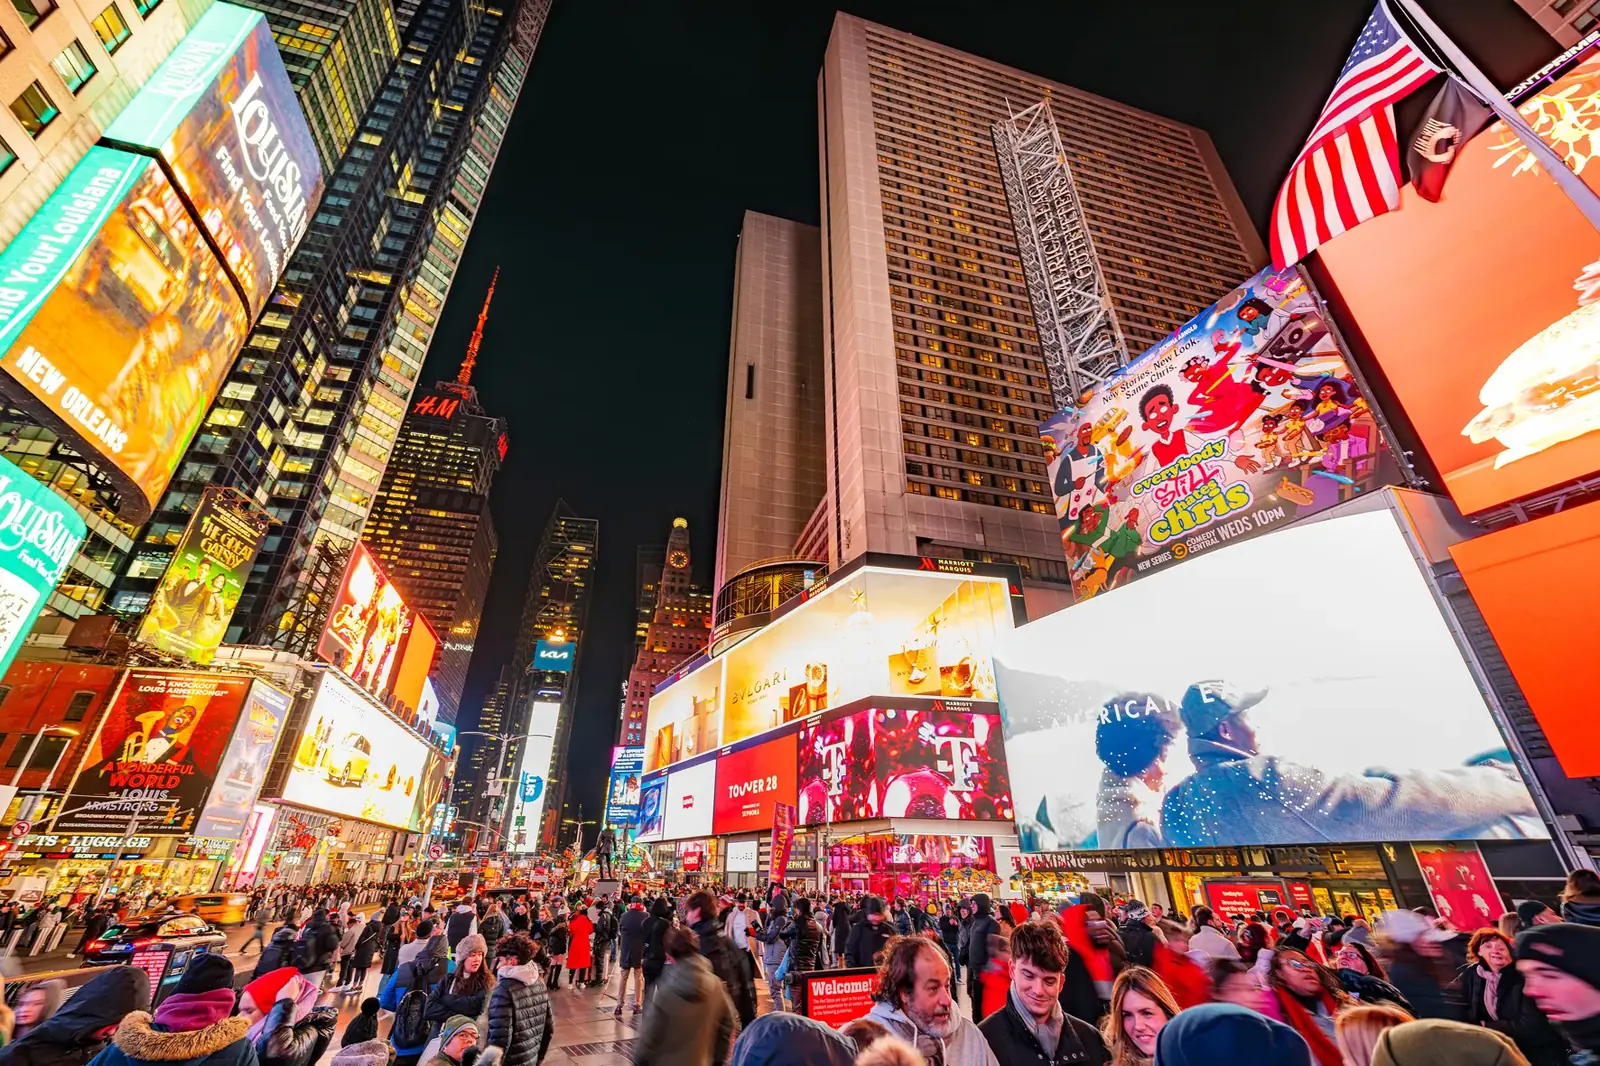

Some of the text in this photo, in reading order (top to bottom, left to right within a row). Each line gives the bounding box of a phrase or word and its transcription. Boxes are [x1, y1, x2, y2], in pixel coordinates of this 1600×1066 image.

[216, 145, 244, 193] Find
[239, 187, 264, 232] Your
[4, 242, 63, 283] Your
[38, 167, 123, 245] Louisiana
[1176, 323, 1198, 340] ARNOLD
[1102, 338, 1201, 405] New Stories. New Look.
[1125, 365, 1178, 400] Same Chris.
[16, 346, 128, 452] NEW ORLEANS
[413, 395, 460, 420] H&M
[1132, 439, 1226, 494] everybody
[1175, 480, 1218, 519] hates
[1150, 484, 1251, 543] chris
[200, 522, 222, 541] THE
[1217, 506, 1286, 540] WEDS 10PM
[219, 530, 255, 562] GREAT
[1186, 529, 1216, 548] COMEDY
[1188, 537, 1220, 555] CENTRAL
[200, 538, 244, 569] GATSBY
[1137, 550, 1173, 572] NEW SERIES
[938, 558, 975, 568] MARRIOTT
[938, 565, 972, 573] MARQUIS
[808, 576, 830, 592] MARRIOTT
[808, 584, 828, 598] MARQUIS
[138, 685, 166, 693] LOUIS
[168, 681, 217, 689] KNOCKOUT
[732, 667, 788, 705] BVLGARI
[103, 761, 114, 771] A
[116, 761, 196, 775] WONDERFUL
[108, 773, 182, 790] WORLD
[728, 775, 778, 798] TOWER 28
[120, 788, 170, 800] LOUIS
[84, 800, 159, 812] ARMSTRONG
[17, 835, 152, 848] IFTS LUGGAGE
[786, 860, 811, 869] SEPHORA
[1220, 899, 1250, 907] Broadway's
[811, 978, 872, 996] Welcome!
